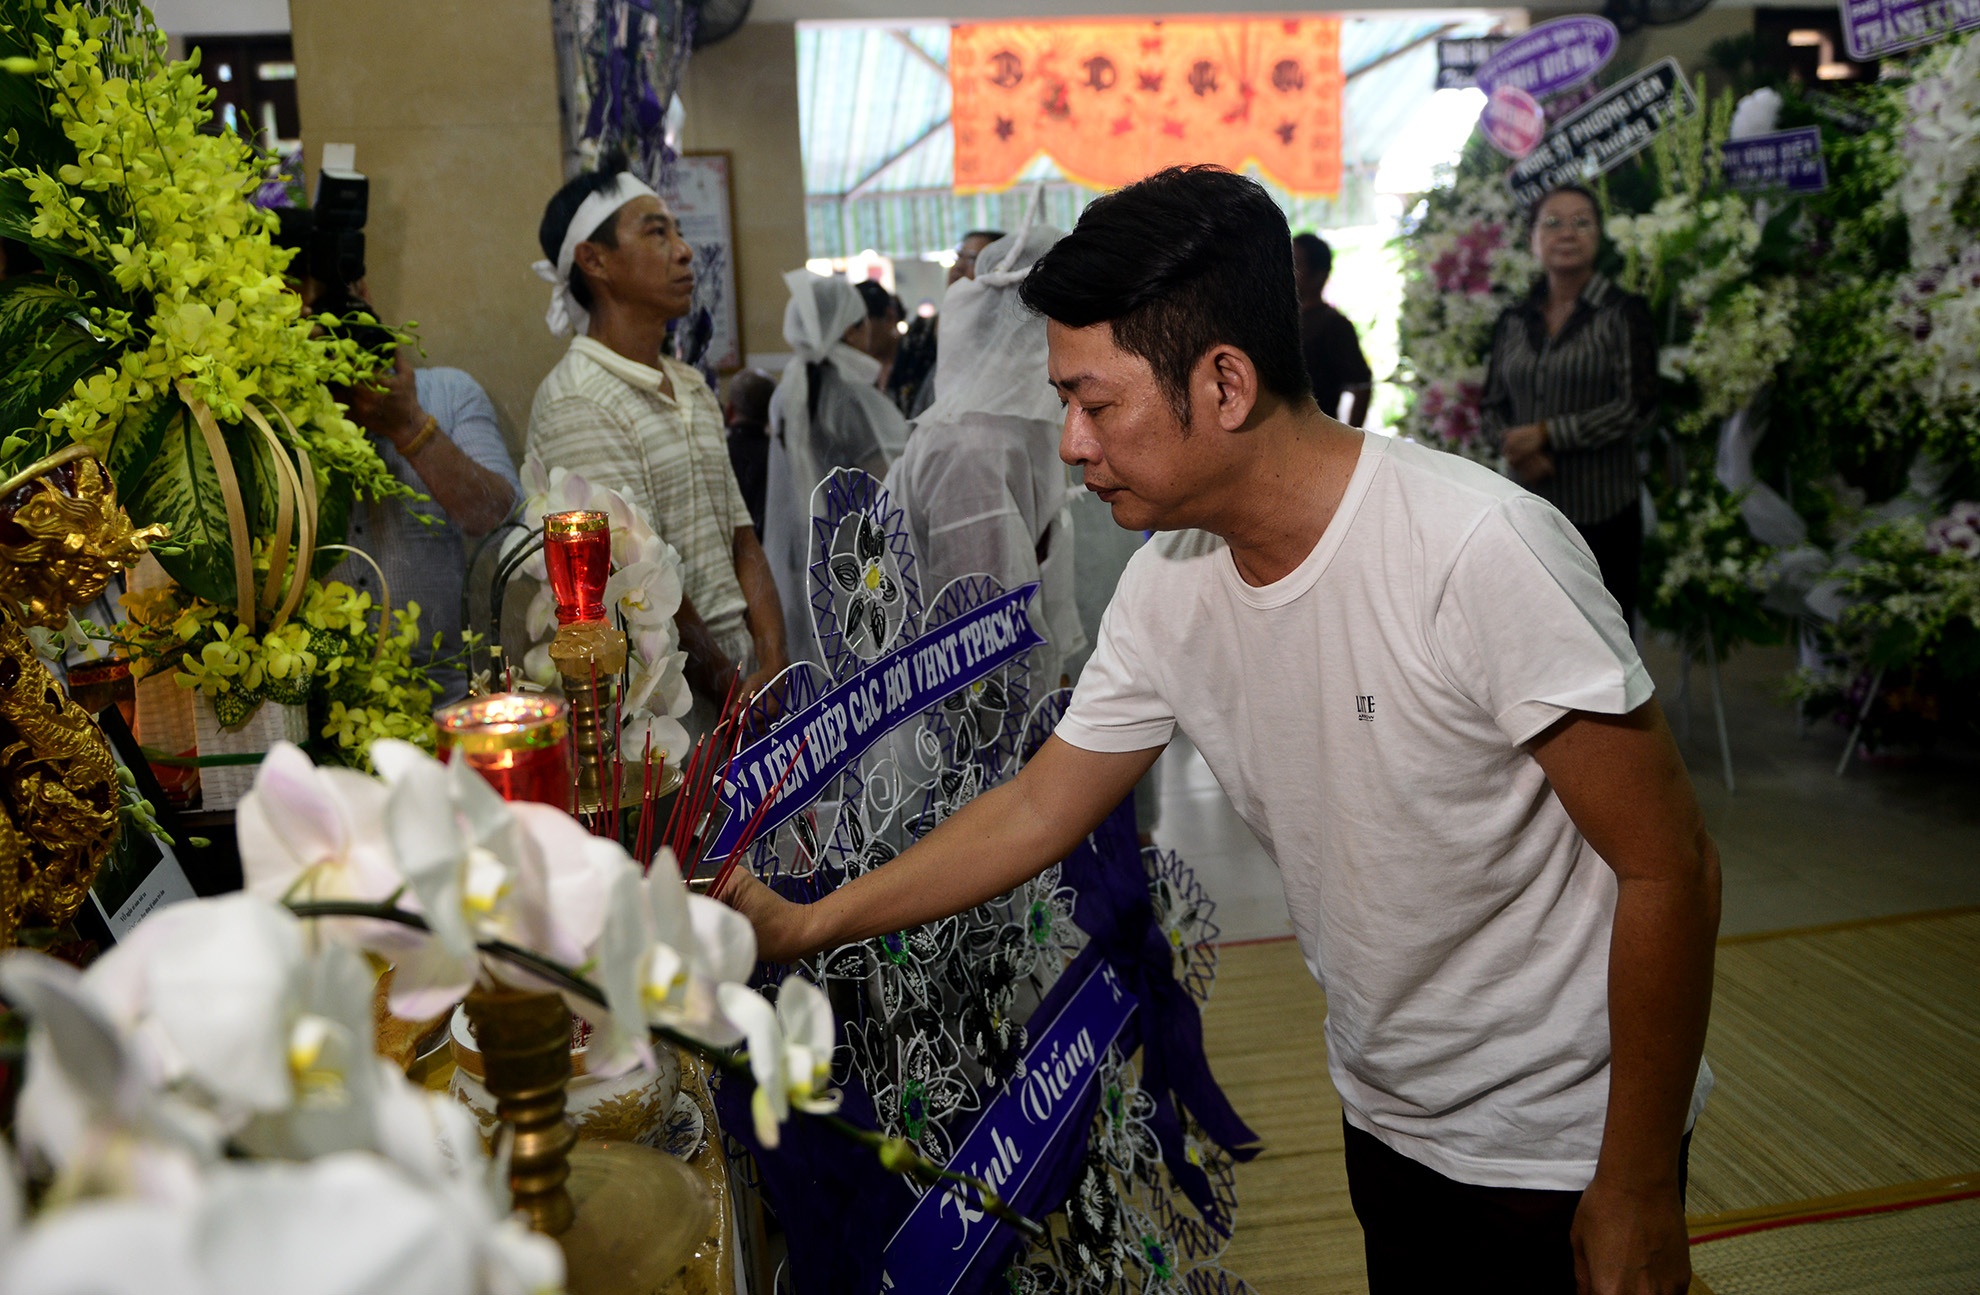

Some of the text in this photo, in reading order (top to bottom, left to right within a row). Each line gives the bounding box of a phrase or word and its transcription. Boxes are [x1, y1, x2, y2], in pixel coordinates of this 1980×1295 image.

[750, 734, 809, 811] LIÊN
[803, 702, 847, 774] HIỆP
[849, 671, 882, 735] CÁC
[883, 655, 912, 714] HỘI
[913, 632, 961, 693] VHNT
[940, 1027, 1095, 1250] Kính Viếng
